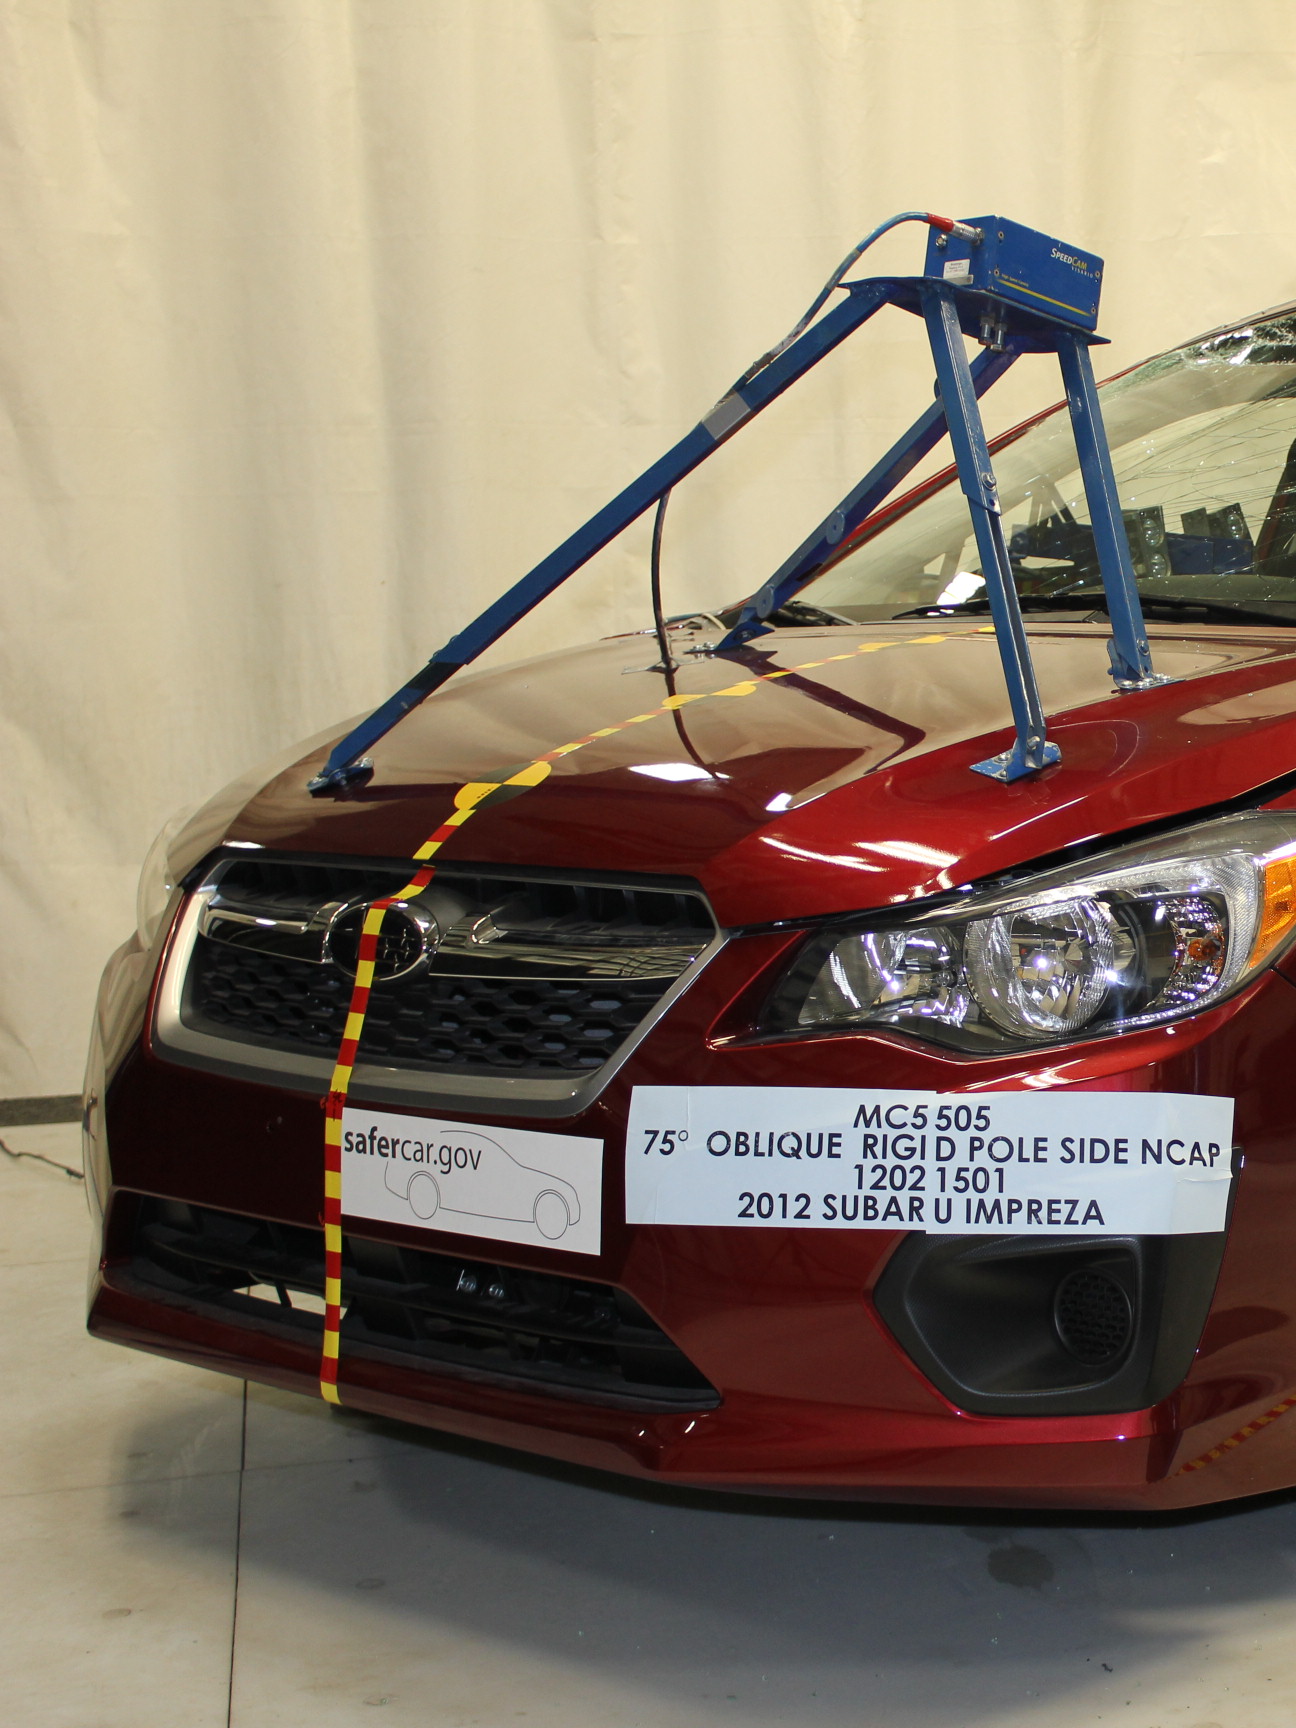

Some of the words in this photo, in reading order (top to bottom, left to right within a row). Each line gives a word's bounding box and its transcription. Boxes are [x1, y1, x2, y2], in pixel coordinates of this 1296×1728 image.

[853, 1104, 991, 1132] MC5505
[344, 1126, 482, 1175] safercar.gov
[643, 1129, 689, 1157] 75°
[706, 1130, 842, 1161] OBLIQUE
[862, 1133, 956, 1162] RIGID
[970, 1136, 1047, 1164] POLE
[1060, 1137, 1128, 1165] SIDE
[1141, 1139, 1220, 1168] NCAP
[854, 1165, 1005, 1194] 12021501
[738, 1193, 813, 1220] 2012
[822, 1194, 953, 1224] SUBARU
[965, 1198, 1105, 1227] IMPREZA
